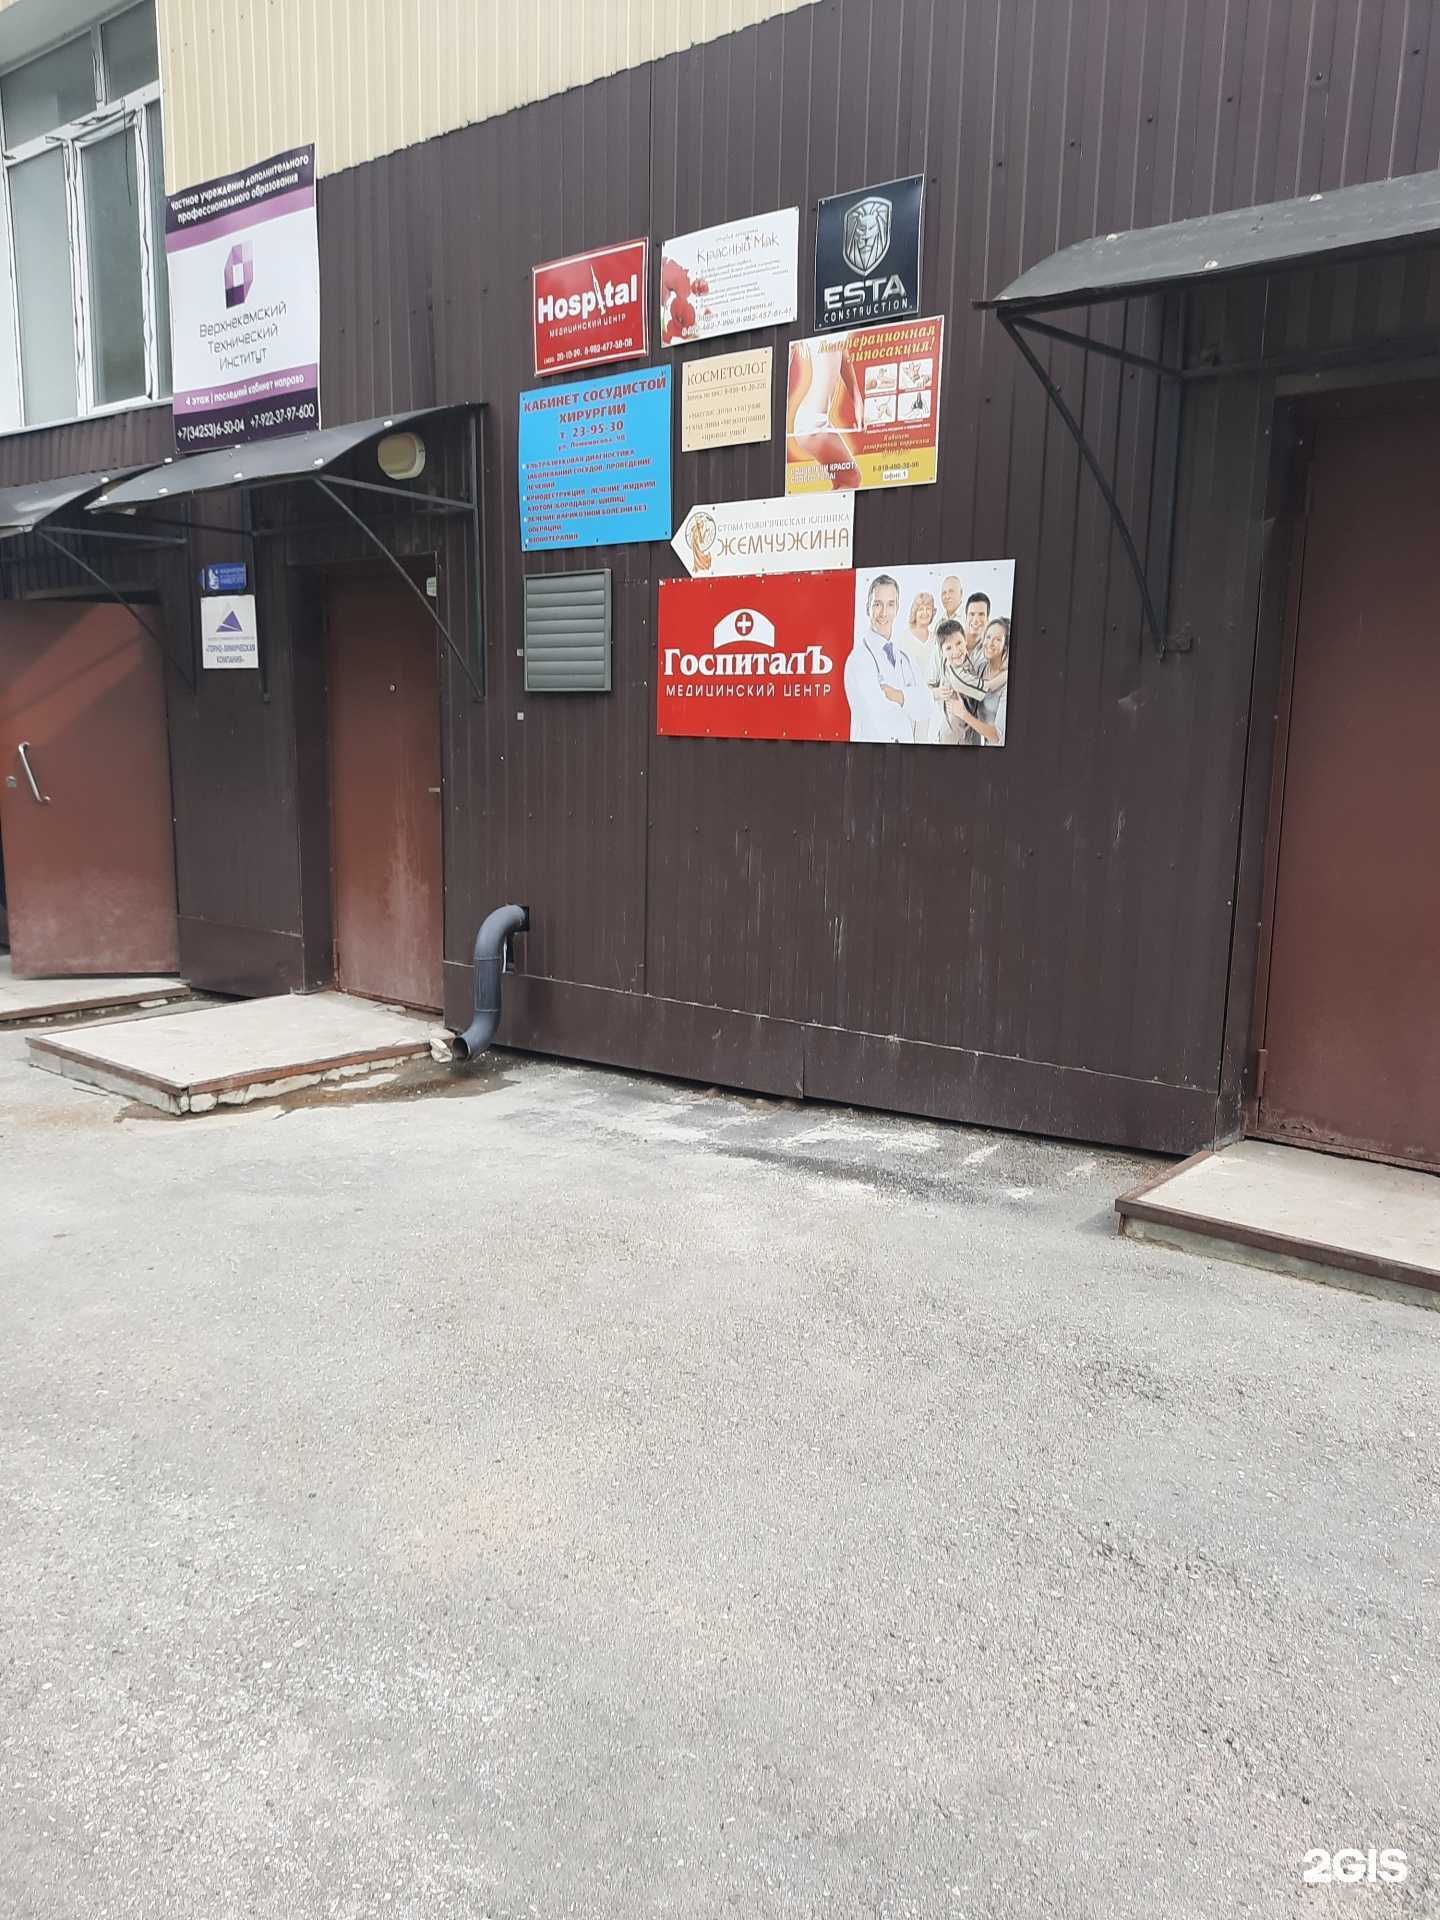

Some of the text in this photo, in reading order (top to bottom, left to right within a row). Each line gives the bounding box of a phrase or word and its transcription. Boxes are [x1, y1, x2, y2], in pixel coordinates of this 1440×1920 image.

[200, 179, 245, 204] учреждение
[246, 154, 309, 188] дополнительного
[177, 173, 299, 224] профессионального образования
[537, 268, 638, 324] Hospital
[824, 274, 907, 309] ESTA
[199, 301, 287, 337] Верхнекамский
[823, 297, 909, 323] CONSTRUCTION
[207, 323, 279, 354] Технический
[549, 313, 626, 338] МЕДИЦИНСКИЙ ЦЕНТР
[219, 348, 267, 371] Институт
[687, 361, 767, 386] КОСМЕТОЛОГ
[214, 385, 248, 402] последний
[524, 375, 666, 412] КАБИНЕТ СОСУДИСТОЙ
[250, 403, 315, 428] +7-922-37-97-600
[559, 403, 626, 423] ХИРУРГИИ
[716, 527, 849, 556] ЖЕМЧУЖИНА
[666, 681, 832, 697] МЕДИЦИНСКИЙ ЦЕНТР
